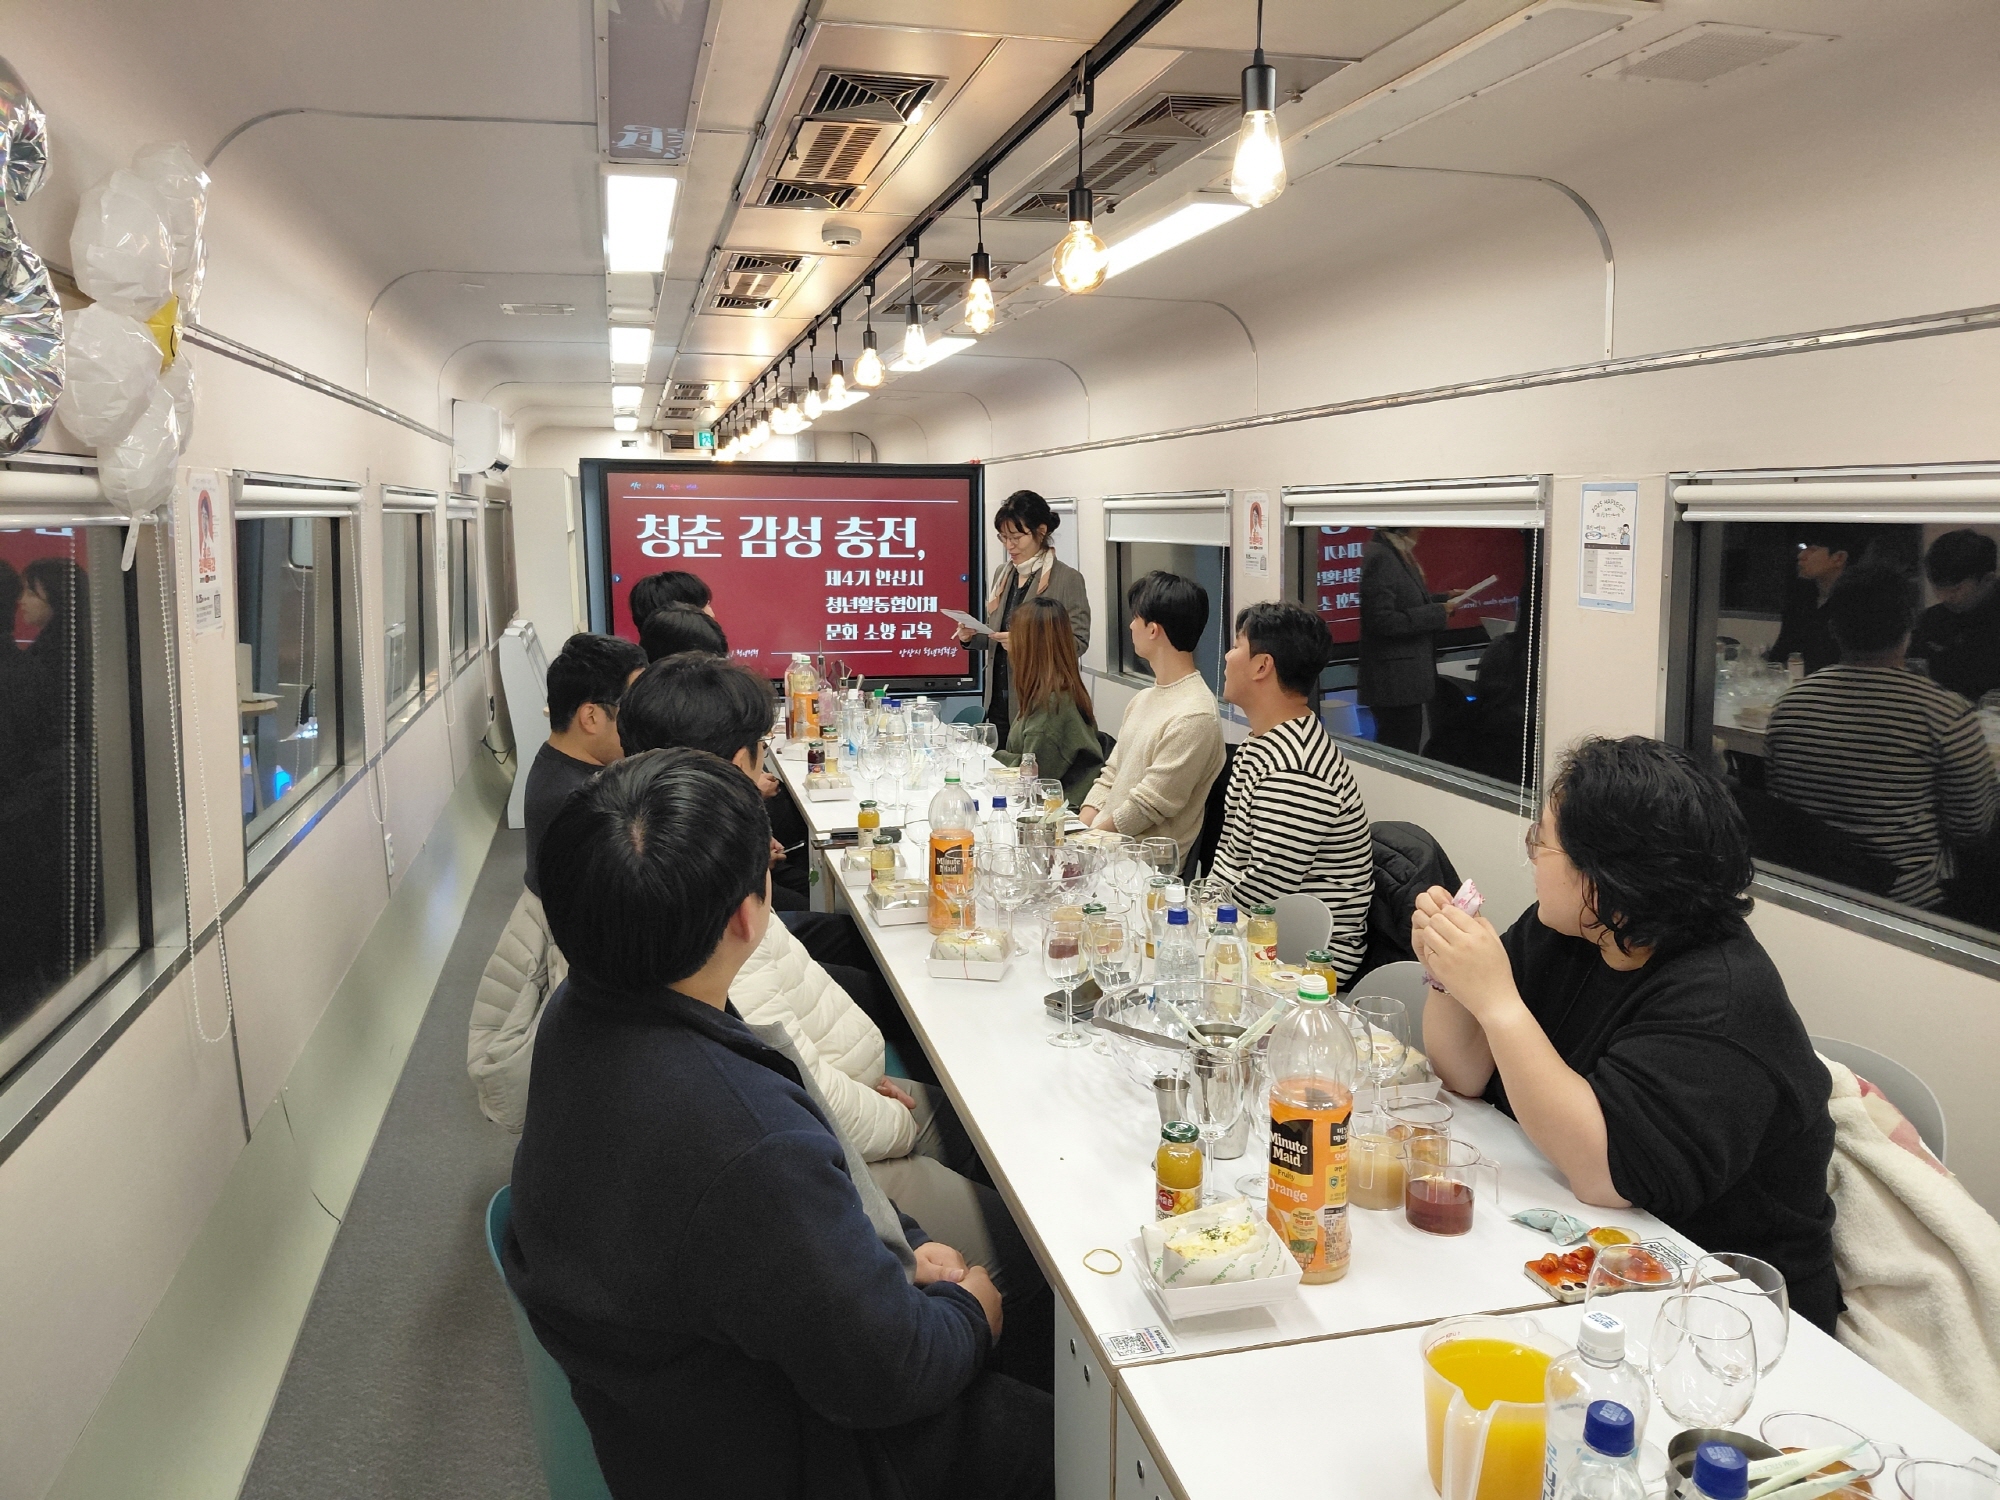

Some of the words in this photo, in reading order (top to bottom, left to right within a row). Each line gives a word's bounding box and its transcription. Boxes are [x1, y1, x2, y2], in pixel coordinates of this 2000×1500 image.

[636, 514, 725, 558] 청춘
[738, 516, 823, 559] 감성
[834, 516, 926, 561] 충전,
[824, 569, 871, 587] 제4기
[875, 567, 924, 587] 안산시
[825, 595, 938, 614] 청년활동협의체
[825, 622, 859, 641] 문화
[863, 621, 897, 640] 소양
[900, 621, 933, 640] 교육
[898, 648, 922, 658] 안산시
[1270, 1130, 1308, 1155] Minute
[1272, 1145, 1302, 1167] Maid
[1277, 1168, 1295, 1181] Fruity
[1268, 1177, 1308, 1203] Orange
